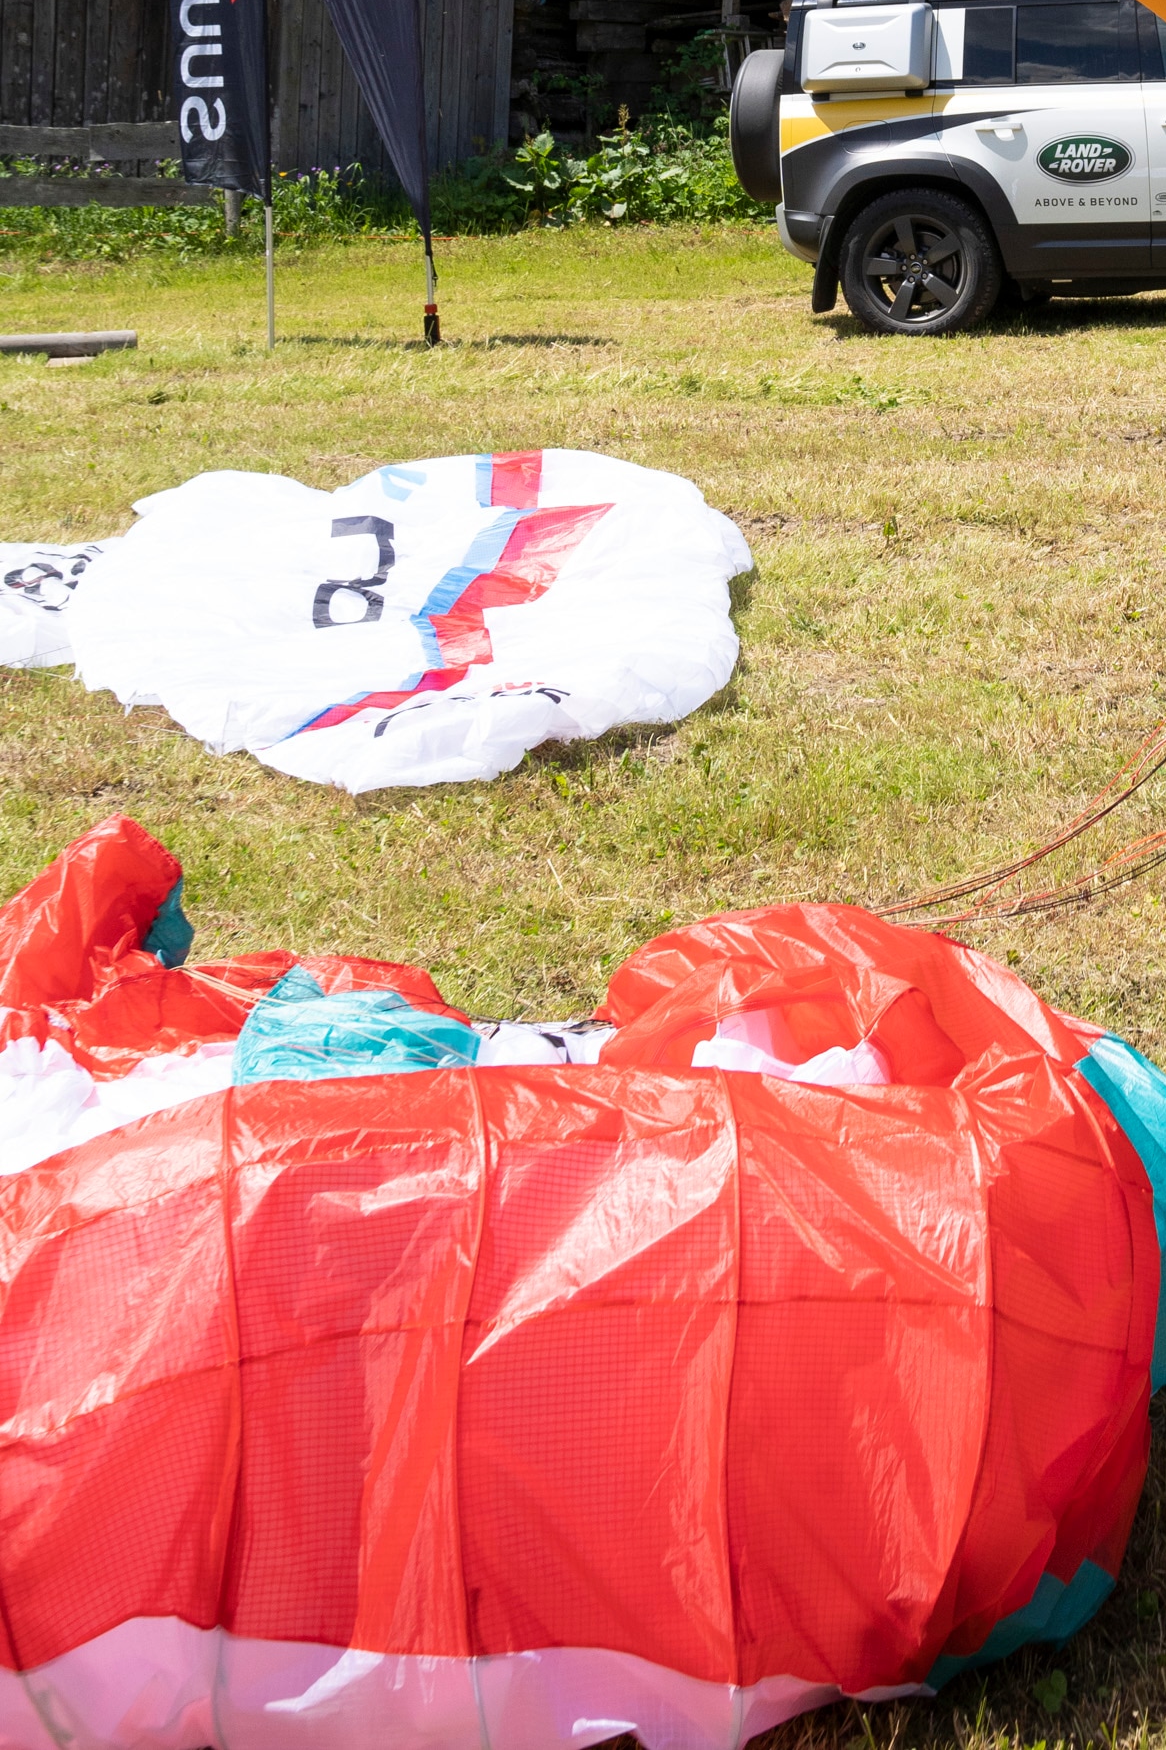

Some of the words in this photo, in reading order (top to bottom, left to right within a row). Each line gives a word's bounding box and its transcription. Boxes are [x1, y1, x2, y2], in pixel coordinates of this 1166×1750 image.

[1054, 143, 1103, 158] LAND
[1058, 158, 1117, 173] ROVER
[1034, 197, 1075, 207] ABOVE
[1078, 197, 1086, 207] &
[1090, 196, 1138, 207] BEYOND
